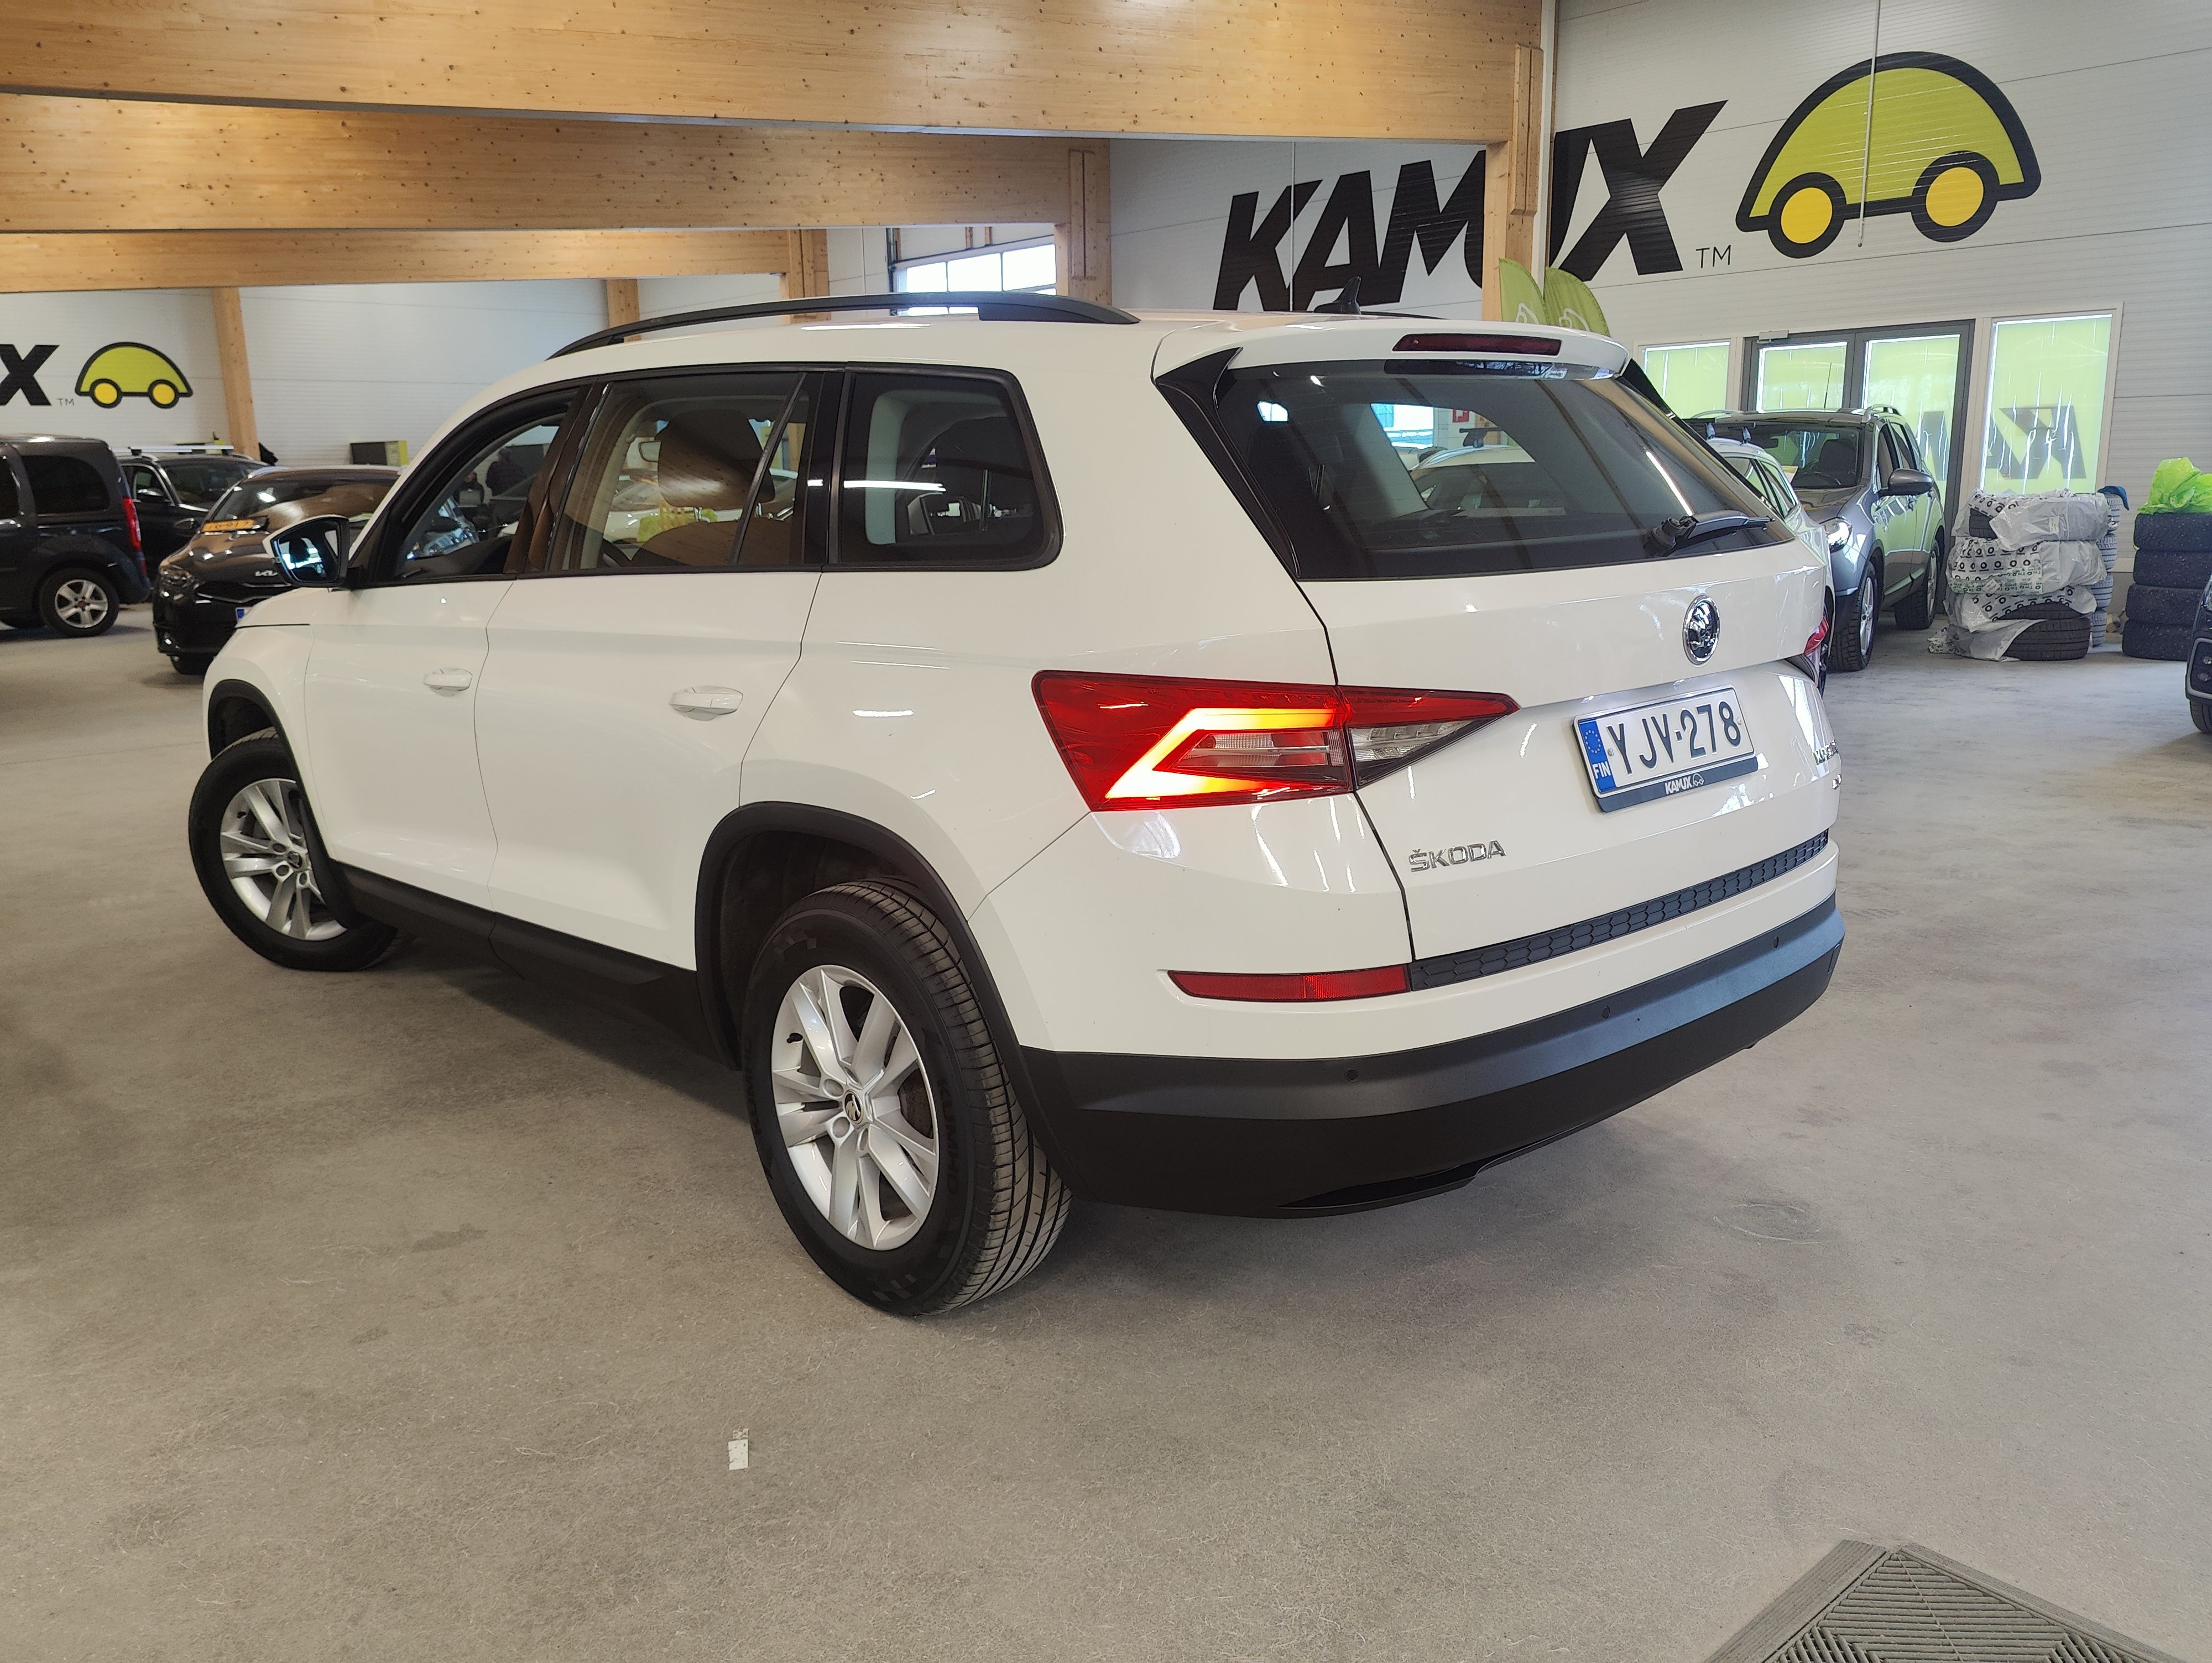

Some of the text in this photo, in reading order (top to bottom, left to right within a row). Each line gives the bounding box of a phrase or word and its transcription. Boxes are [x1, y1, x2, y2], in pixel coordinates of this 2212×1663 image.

[1695, 244, 1731, 268] TM
[0, 344, 60, 406] X
[57, 398, 75, 406] TM
[1606, 701, 1741, 775] YJV-278
[1592, 761, 1611, 779] FIN
[1665, 776, 1693, 795] KAMUX
[1408, 840, 1507, 872] ŠKODA
[937, 1077, 960, 1194] KUMHO
